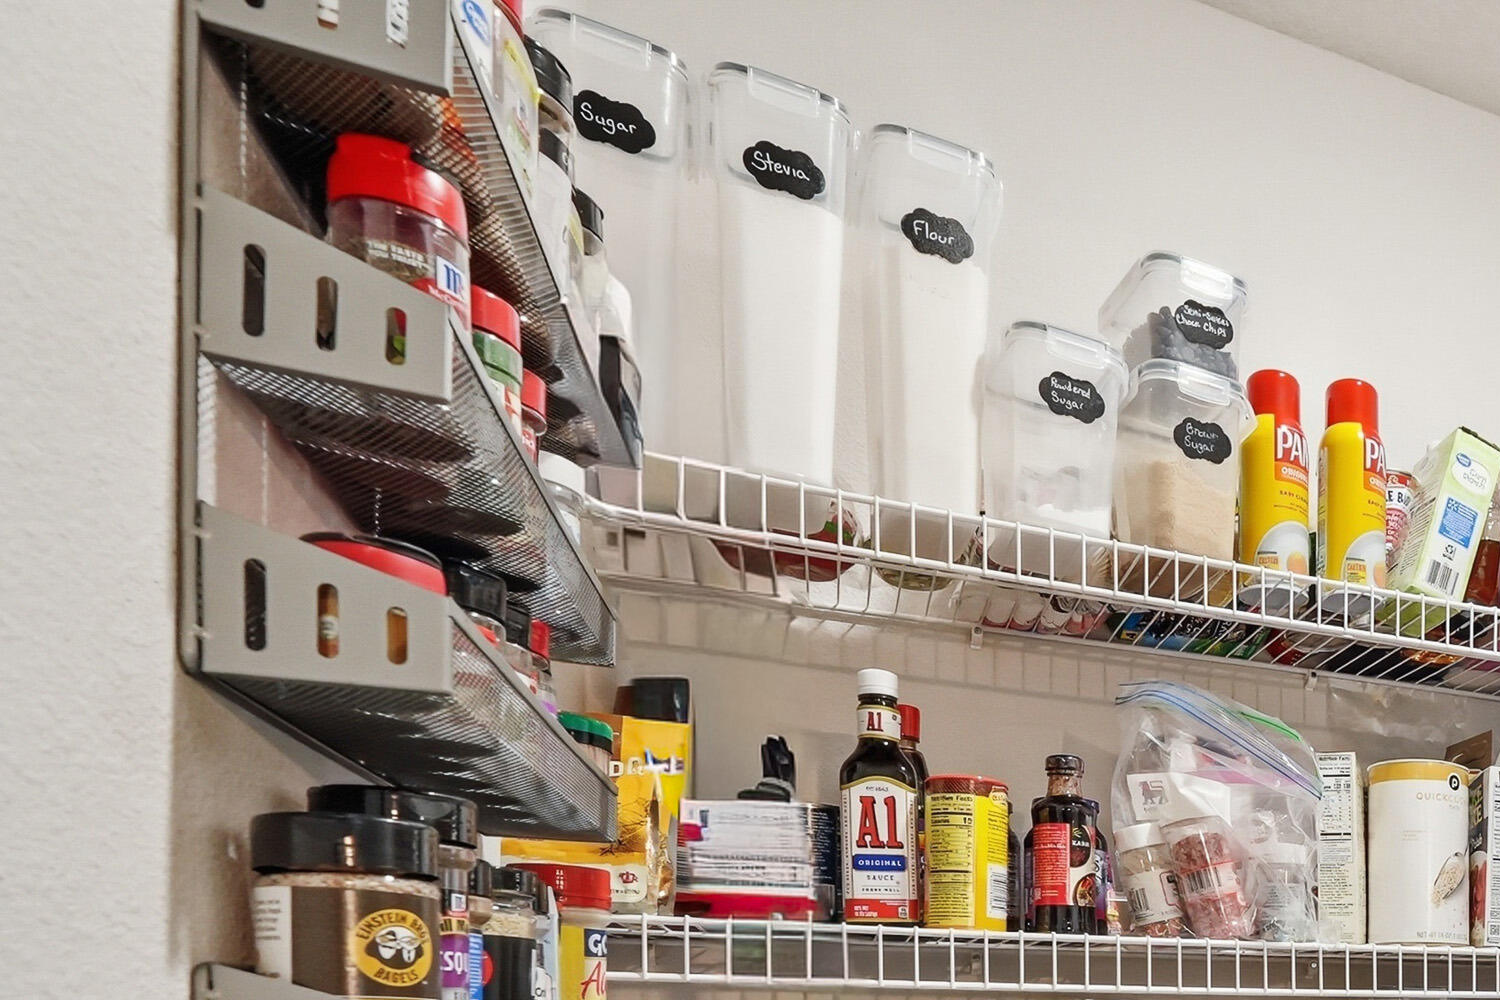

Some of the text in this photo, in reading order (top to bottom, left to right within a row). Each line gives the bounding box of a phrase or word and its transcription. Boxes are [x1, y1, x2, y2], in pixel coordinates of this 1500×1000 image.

[580, 102, 637, 136] Sugar
[751, 150, 811, 182] Stevia
[913, 219, 955, 248] Flour
[1051, 376, 1091, 399] Powdered
[1051, 390, 1085, 410] Sugar
[1184, 435, 1215, 455] Sugar
[858, 859, 902, 867] ORIGINAL
[373, 963, 420, 982] BAGELS
